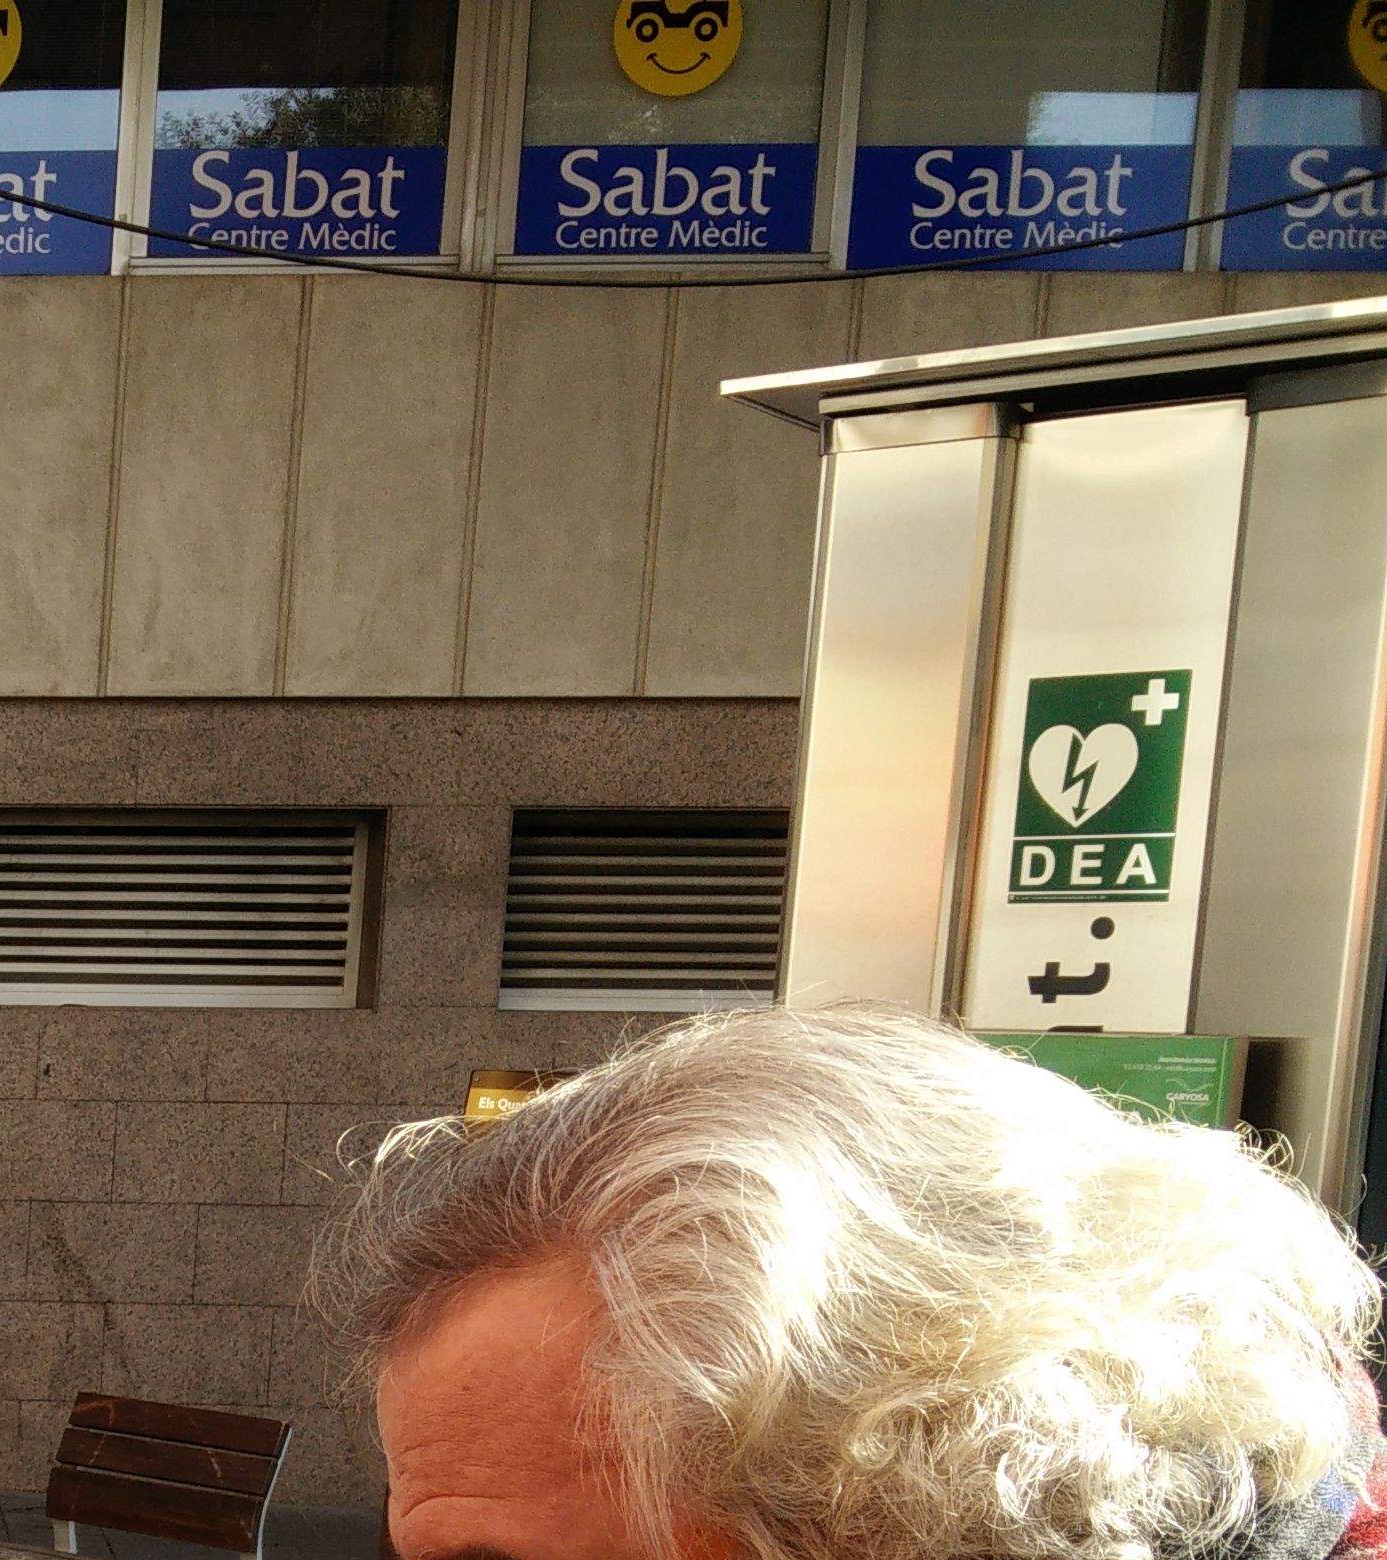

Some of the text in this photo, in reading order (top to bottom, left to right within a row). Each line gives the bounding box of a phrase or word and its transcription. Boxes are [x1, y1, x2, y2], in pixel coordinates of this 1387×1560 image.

[189, 151, 405, 219] Sabat
[558, 148, 776, 217] Sabat
[912, 149, 1133, 218] Sabat
[188, 222, 397, 250] Centre Mèdic
[556, 220, 768, 249] Centre Mèdic
[909, 221, 1125, 250] Centre Mèdic
[1283, 221, 1387, 250] Centre
[1019, 843, 1158, 887] DEA
[478, 1096, 494, 1109] Els
